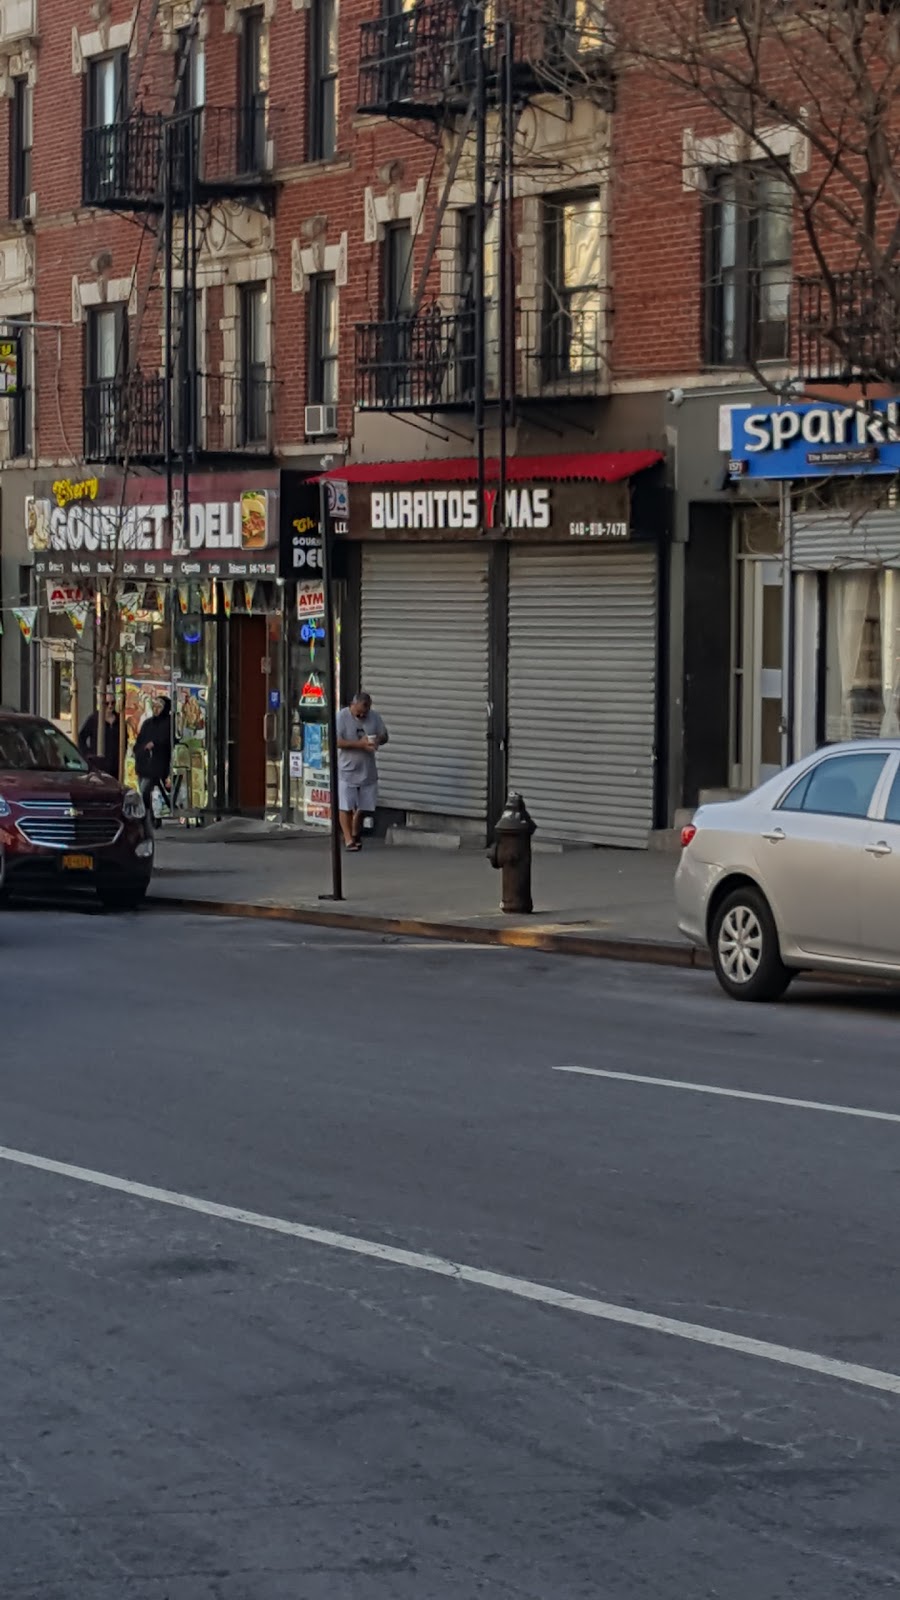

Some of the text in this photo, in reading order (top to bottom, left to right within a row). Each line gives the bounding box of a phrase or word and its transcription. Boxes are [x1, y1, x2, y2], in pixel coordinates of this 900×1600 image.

[189, 502, 241, 549] DELI
[371, 489, 550, 529] BURRITOS Y MAS
[299, 592, 324, 606] ATM
